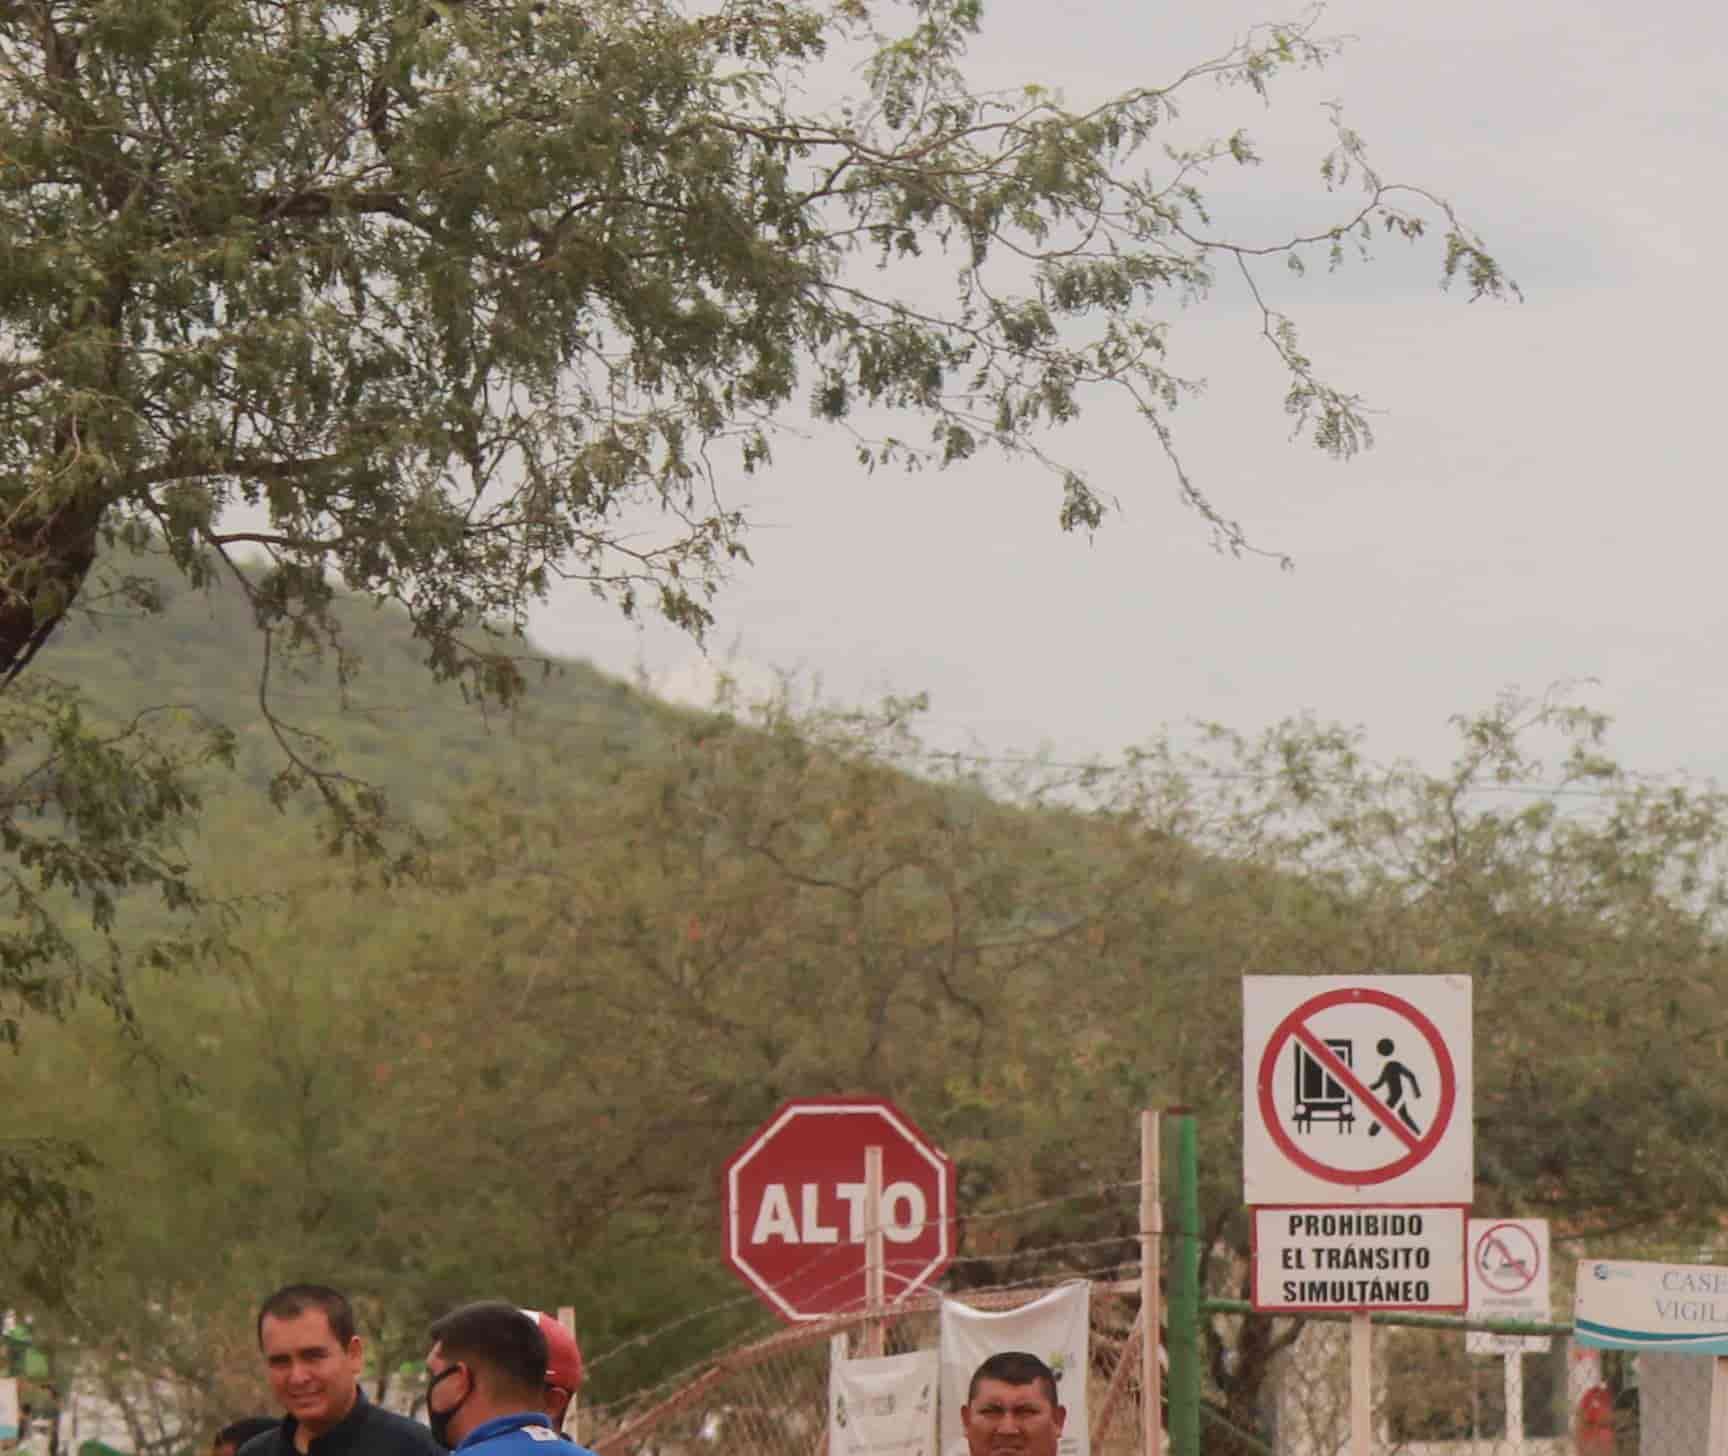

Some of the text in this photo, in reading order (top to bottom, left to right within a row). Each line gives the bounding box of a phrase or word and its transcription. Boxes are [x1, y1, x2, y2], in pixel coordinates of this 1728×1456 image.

[751, 1180, 927, 1245] ALTO
[1288, 1214, 1423, 1237] PROHIBIDO
[1281, 1243, 1431, 1270] EL TRÁNSITO
[1282, 1276, 1431, 1304] SIMULTÁNEO
